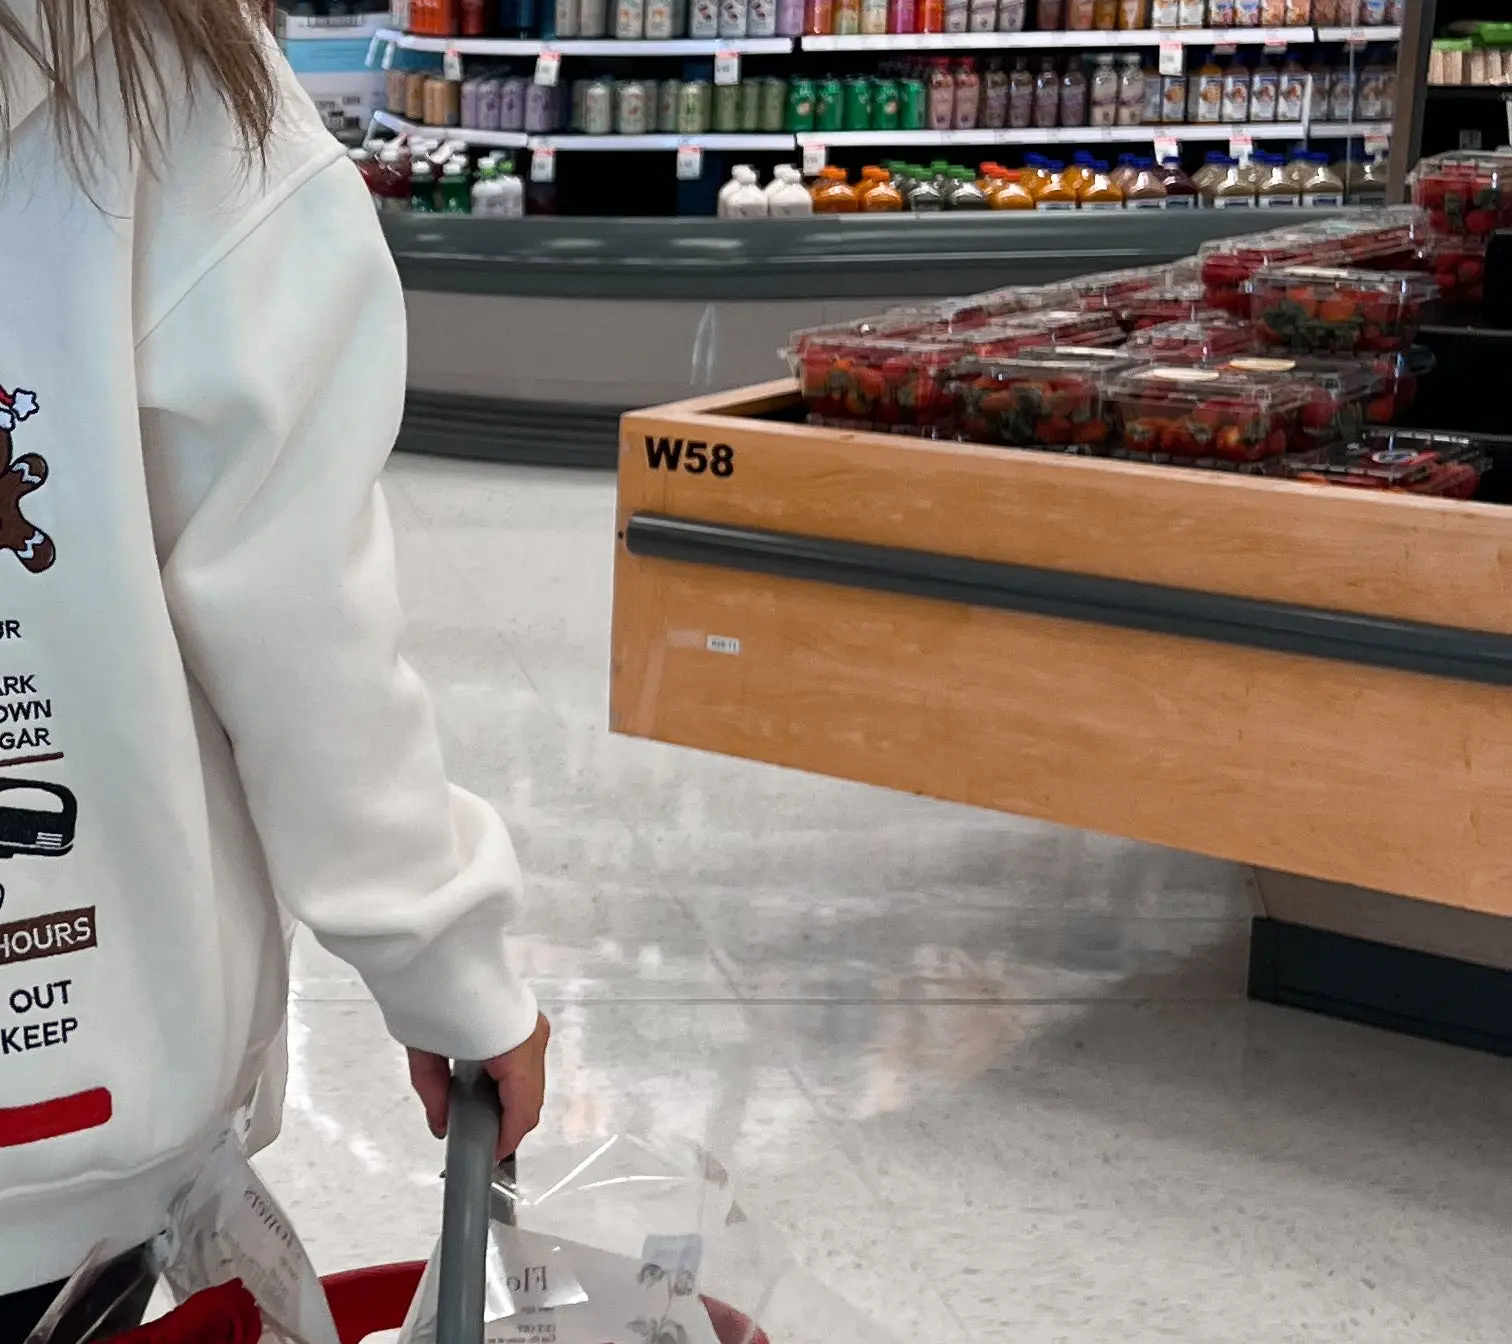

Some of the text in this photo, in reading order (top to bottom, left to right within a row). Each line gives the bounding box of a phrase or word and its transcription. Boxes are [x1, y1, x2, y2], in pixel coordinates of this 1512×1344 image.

[645, 435, 735, 479] W58
[9, 979, 72, 1014] OUT
[0, 1017, 78, 1055] KEEP
